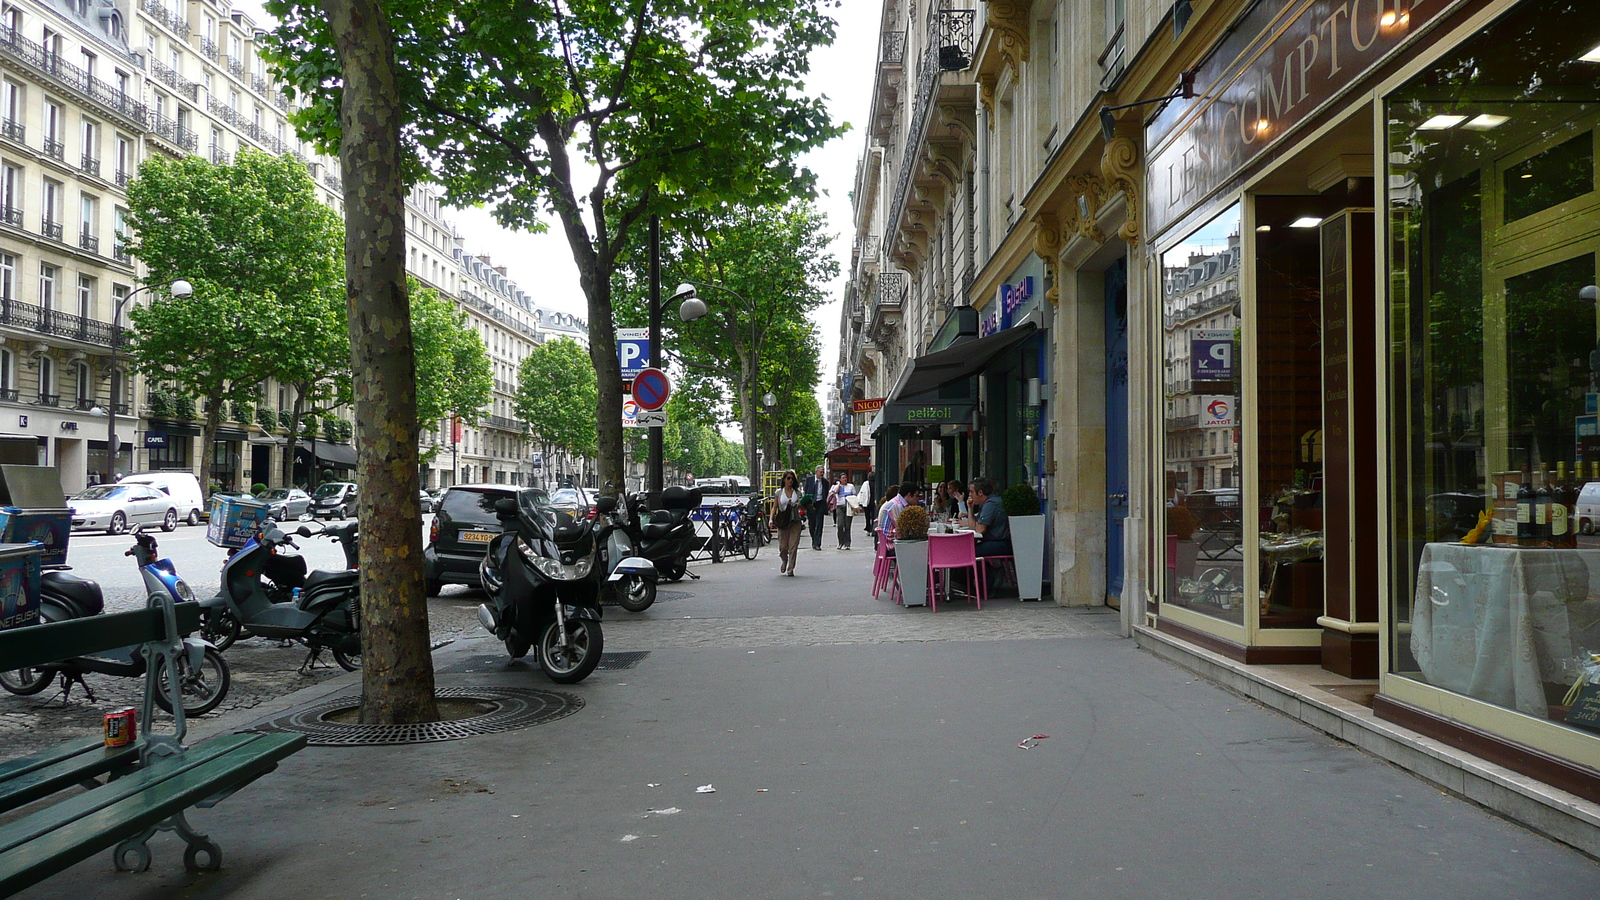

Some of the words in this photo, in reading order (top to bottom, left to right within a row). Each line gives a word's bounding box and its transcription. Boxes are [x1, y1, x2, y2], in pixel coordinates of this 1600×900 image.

[1167, 131, 1210, 209] LES
[1221, 0, 1424, 162] COMPTO
[981, 310, 998, 337] PLANE
[1006, 276, 1030, 313] SUSHI
[621, 342, 640, 368] P
[857, 401, 882, 410] NICOL
[61, 421, 79, 430] CAPEL
[0, 615, 15, 629] NET
[15, 607, 40, 624] SUSHI
